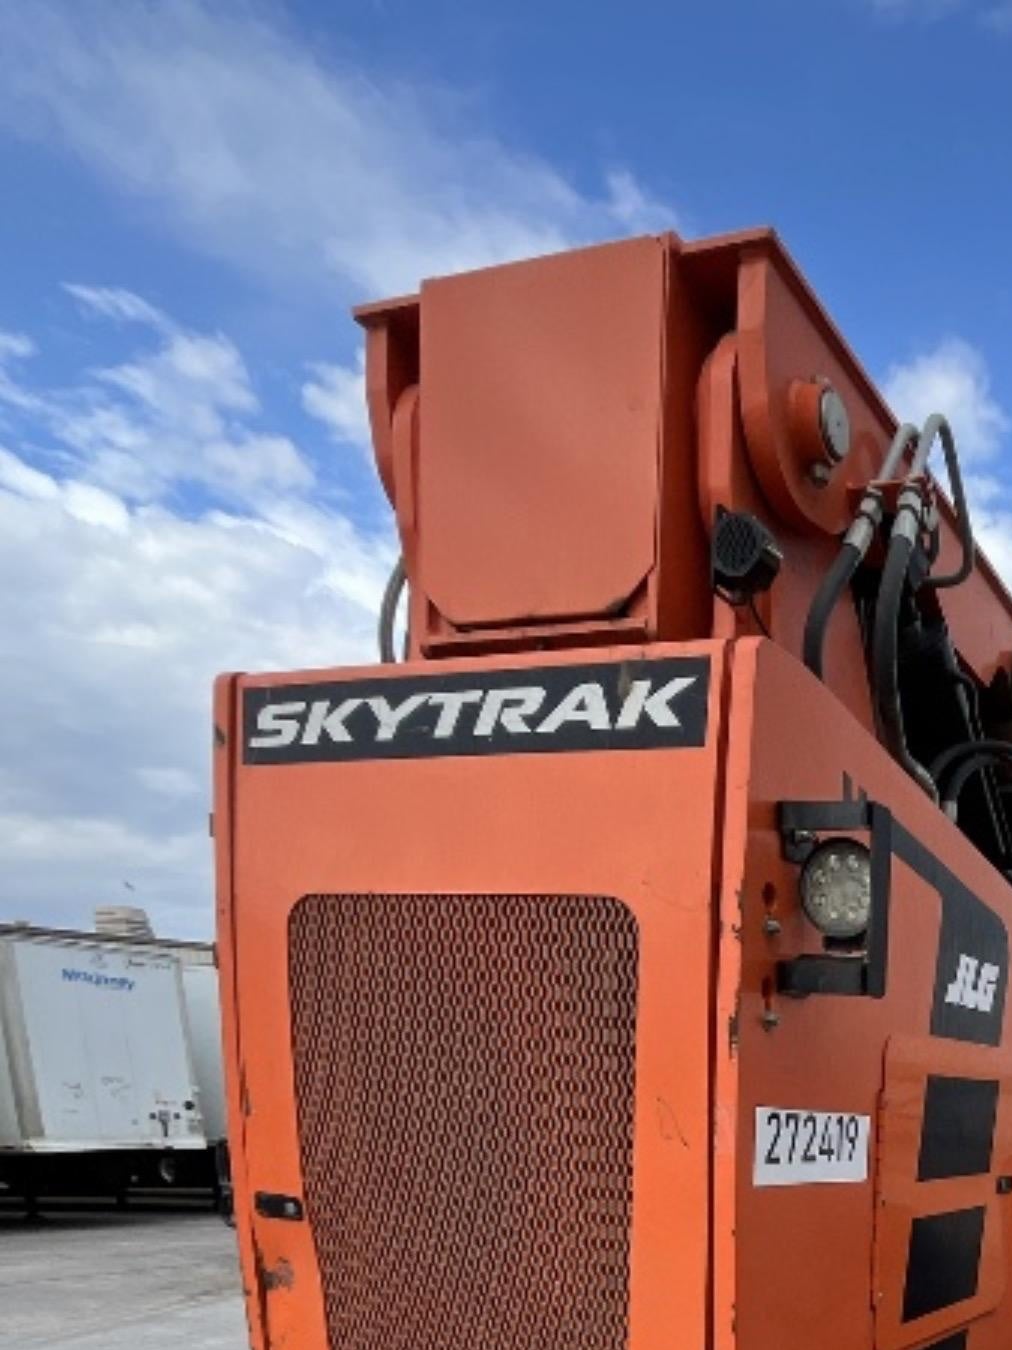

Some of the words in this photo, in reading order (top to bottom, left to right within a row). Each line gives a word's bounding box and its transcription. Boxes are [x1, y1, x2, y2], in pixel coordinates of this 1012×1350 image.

[248, 676, 697, 749] SKYTRAK
[944, 953, 1000, 1012] JLG
[764, 1112, 859, 1165] 272419
